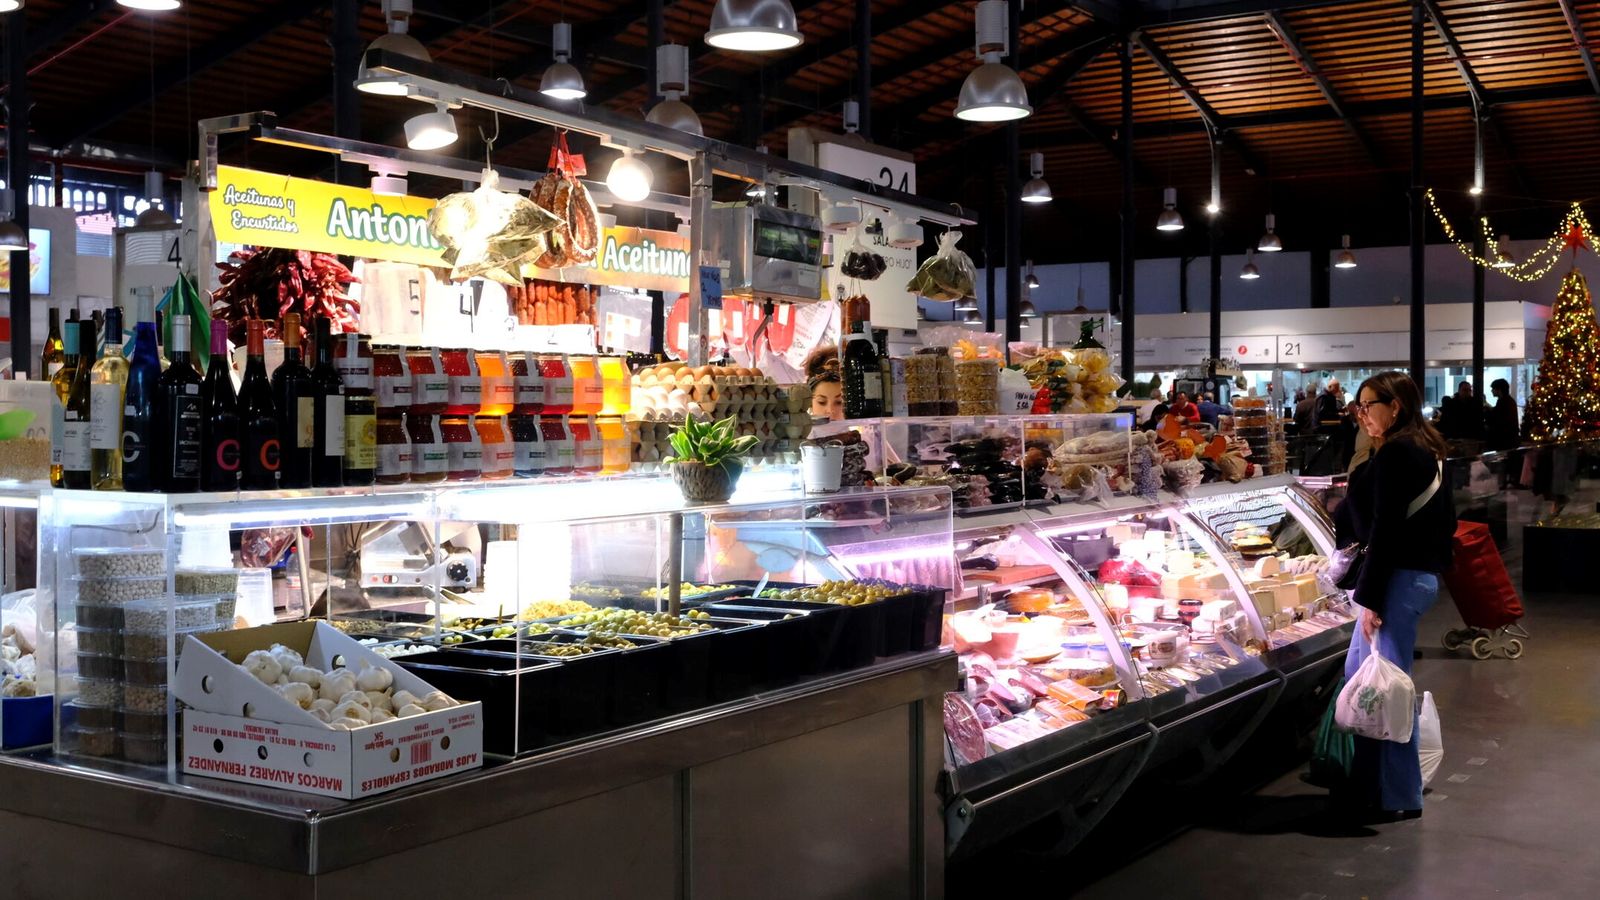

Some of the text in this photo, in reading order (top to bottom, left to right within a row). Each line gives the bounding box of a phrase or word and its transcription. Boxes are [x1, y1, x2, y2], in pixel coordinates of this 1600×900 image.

[223, 183, 295, 217] Aceitunas y
[231, 209, 299, 233] Encurtidos
[167, 237, 182, 268] 4
[1285, 342, 1301, 356] 21
[217, 439, 240, 471] C
[260, 439, 280, 471] C
[188, 756, 343, 792] MARCOS ALVAREZ FERNANDEZ
[361, 753, 477, 792] AJOS MORADOS ESPAÑOLES
